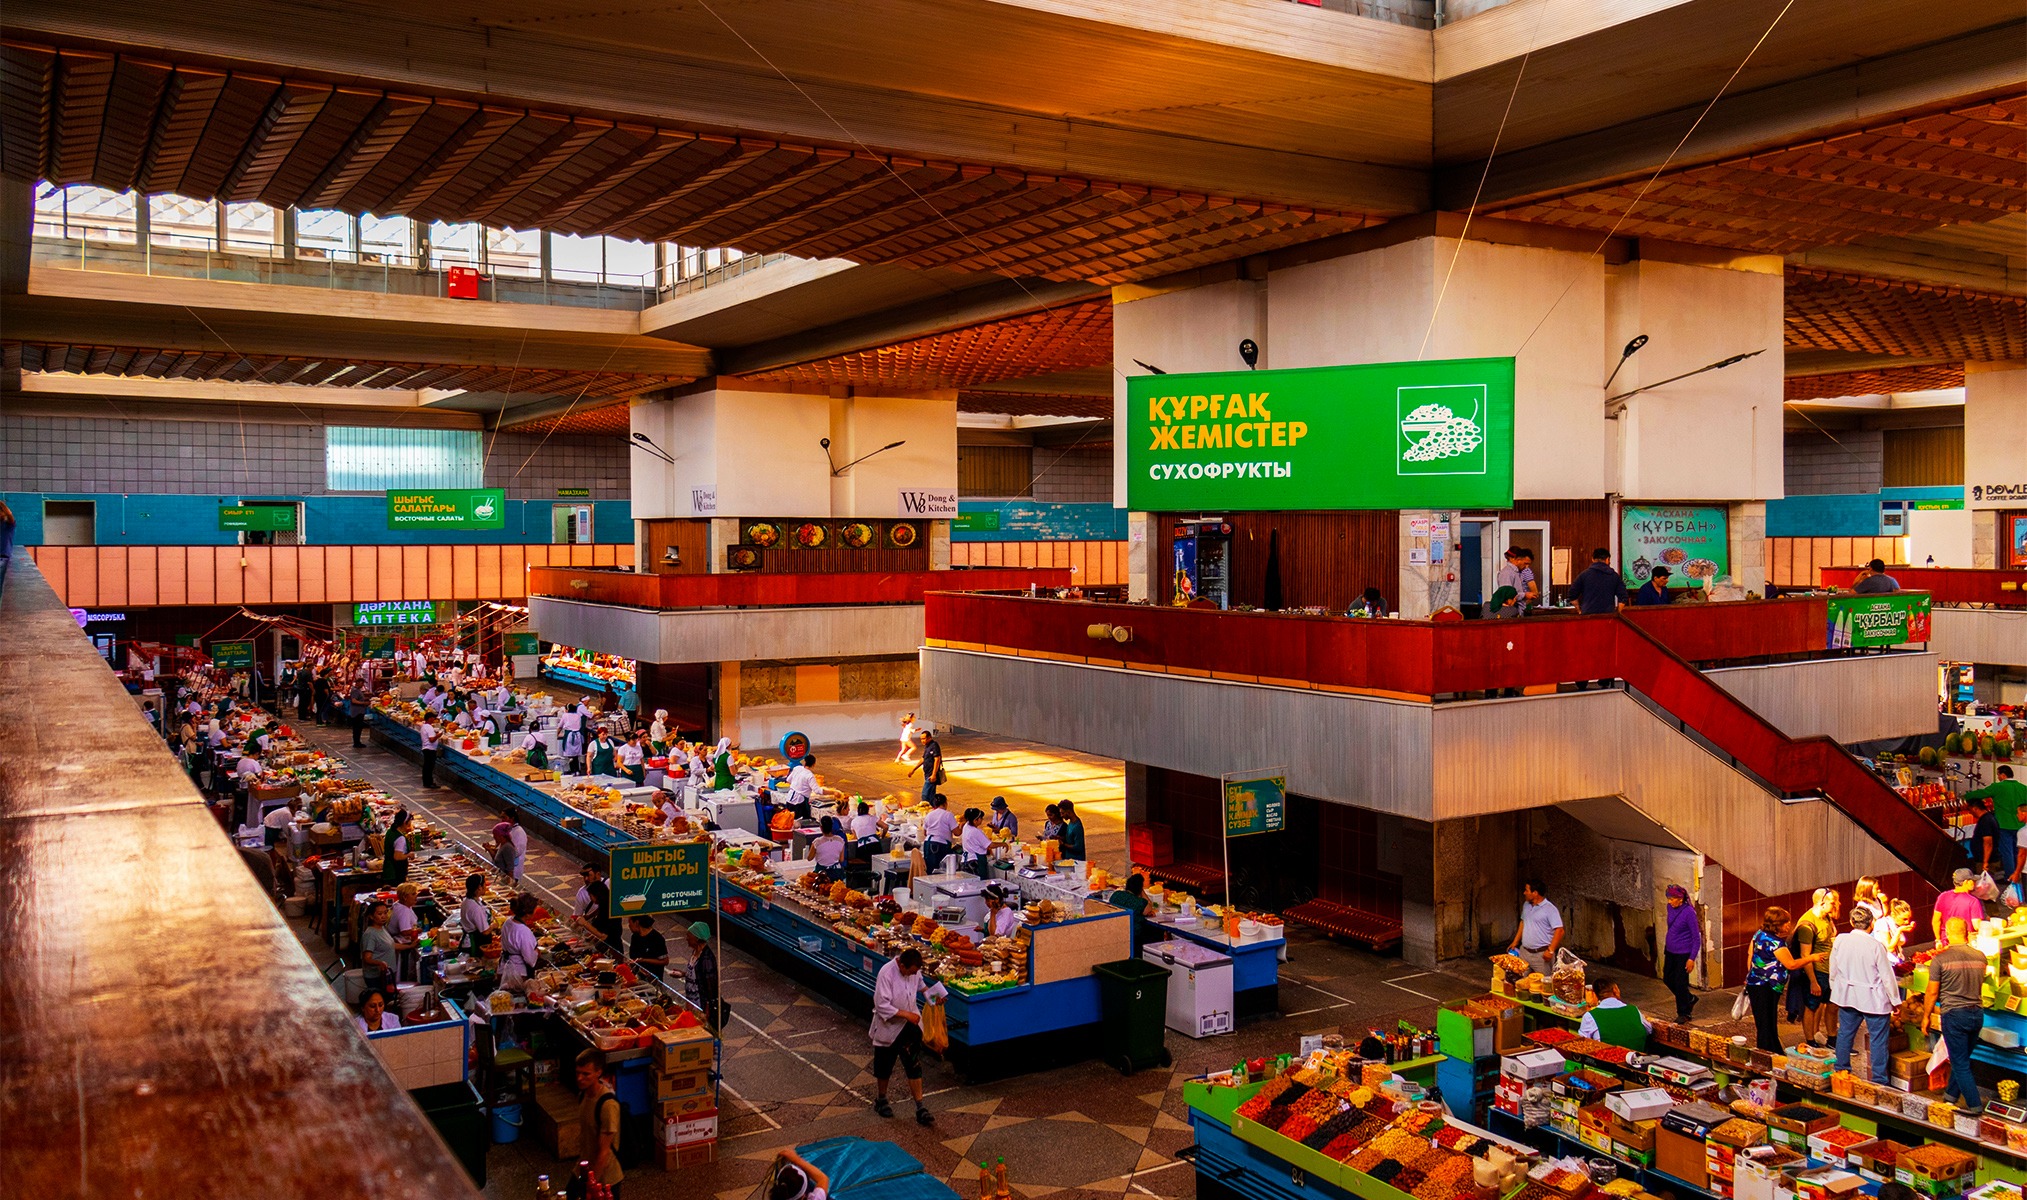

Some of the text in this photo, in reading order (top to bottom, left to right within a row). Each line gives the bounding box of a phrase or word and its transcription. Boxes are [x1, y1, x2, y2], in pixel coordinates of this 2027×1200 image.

[1150, 392, 1271, 426] ҚҰРҒАҚ
[1149, 421, 1308, 450] ЖЕМІСТЕР
[1149, 462, 1292, 480] СУХОФРУКТЫ
[928, 494, 947, 504] Dong
[394, 504, 456, 512] САЛАТТАРЫ
[1634, 520, 1716, 534] «ҚҰРБАН»
[1643, 536, 1706, 544] ЗАКУСОЧНАЯ
[359, 601, 432, 613] ДӘРІХАНА
[359, 614, 432, 624] АПТЕКА
[622, 862, 699, 880] САЛАТТАРЫ
[662, 890, 703, 899] ВОСТОЧНЫЕ
[662, 900, 688, 908] САЛАТЫ
[1136, 990, 1142, 1000] 9
[1292, 1167, 1304, 1187] 84
